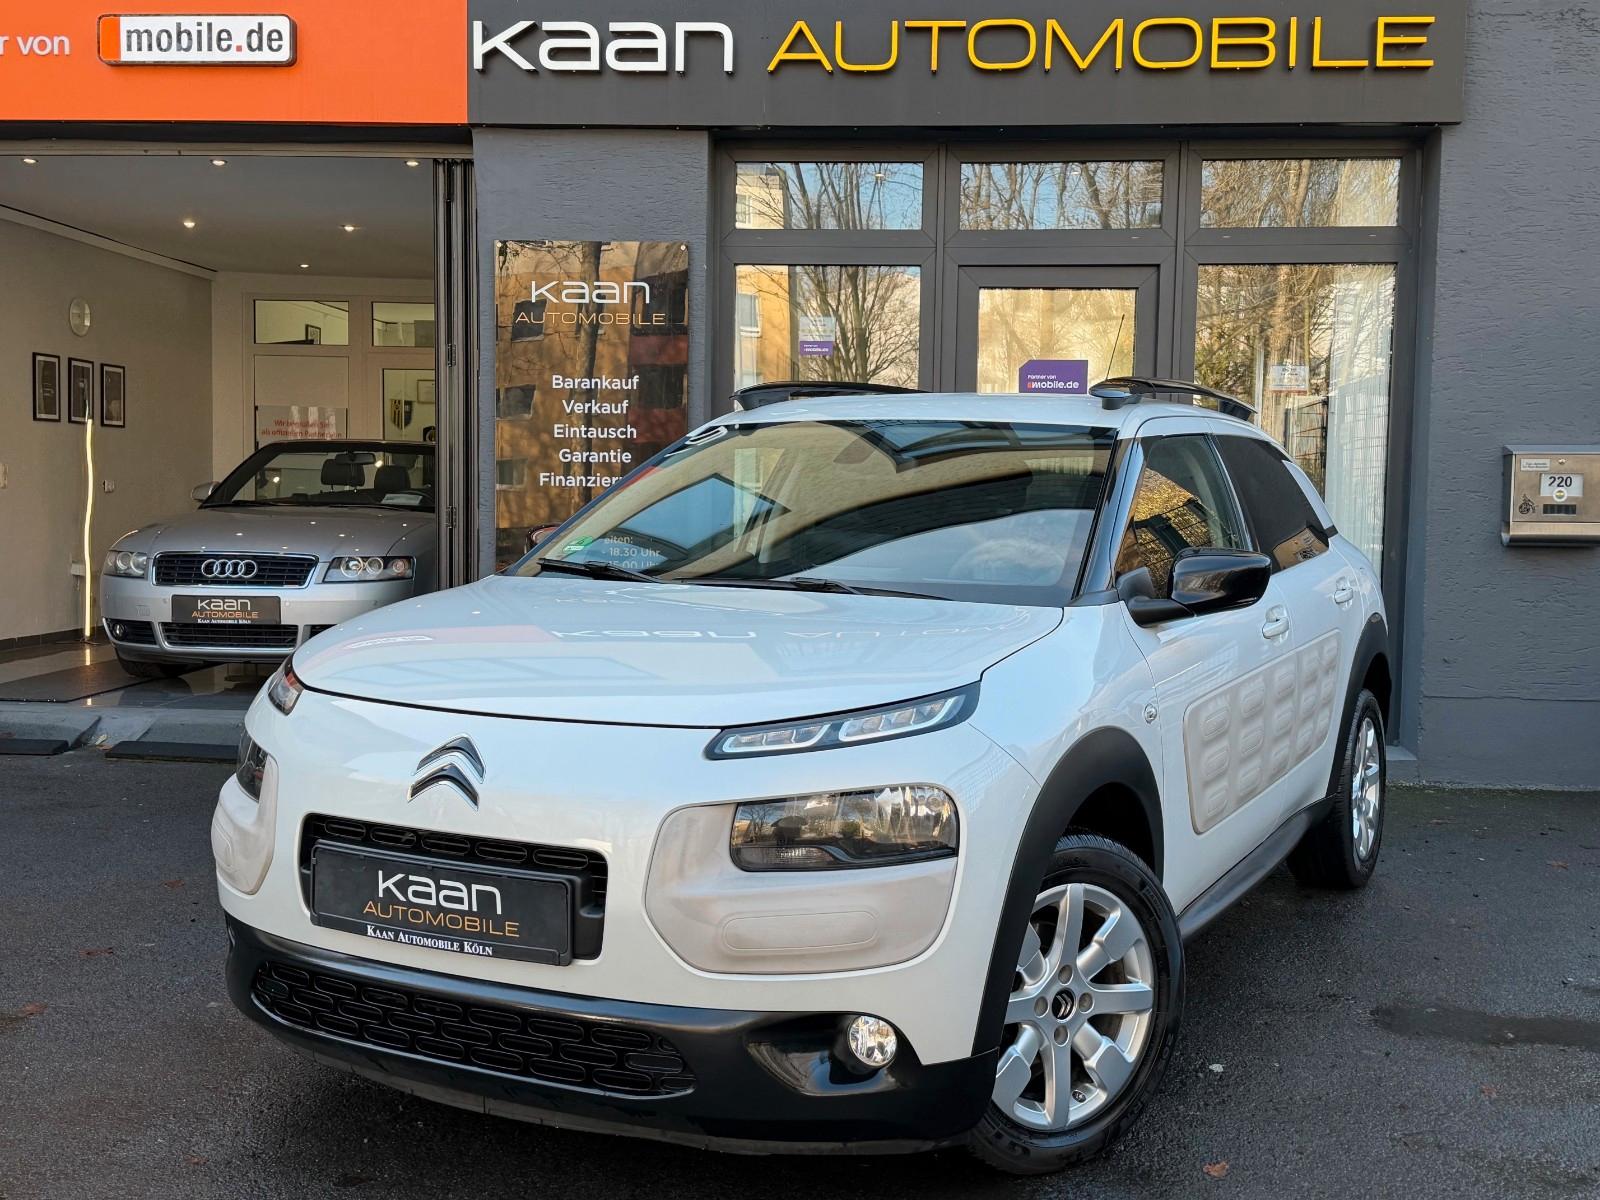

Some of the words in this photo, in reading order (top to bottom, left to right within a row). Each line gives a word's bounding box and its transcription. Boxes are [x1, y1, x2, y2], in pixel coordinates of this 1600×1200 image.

[125, 21, 284, 54] mobile.de
[767, 15, 1436, 73] AUTOMOBILE
[16, 36, 70, 55] von
[515, 311, 667, 325] AUTOMOBILE
[551, 375, 640, 390] Barankauf
[1031, 380, 1080, 389] mobile.de
[562, 399, 629, 414] Verkauf
[553, 423, 637, 438] Eintausch
[558, 448, 632, 463] Garantie
[539, 472, 623, 487] Finanzier
[1548, 476, 1573, 488] 220
[609, 547, 637, 556] 18.30
[191, 610, 259, 619] AUTOMOBILE
[362, 899, 521, 938] AUTOMOBILE
